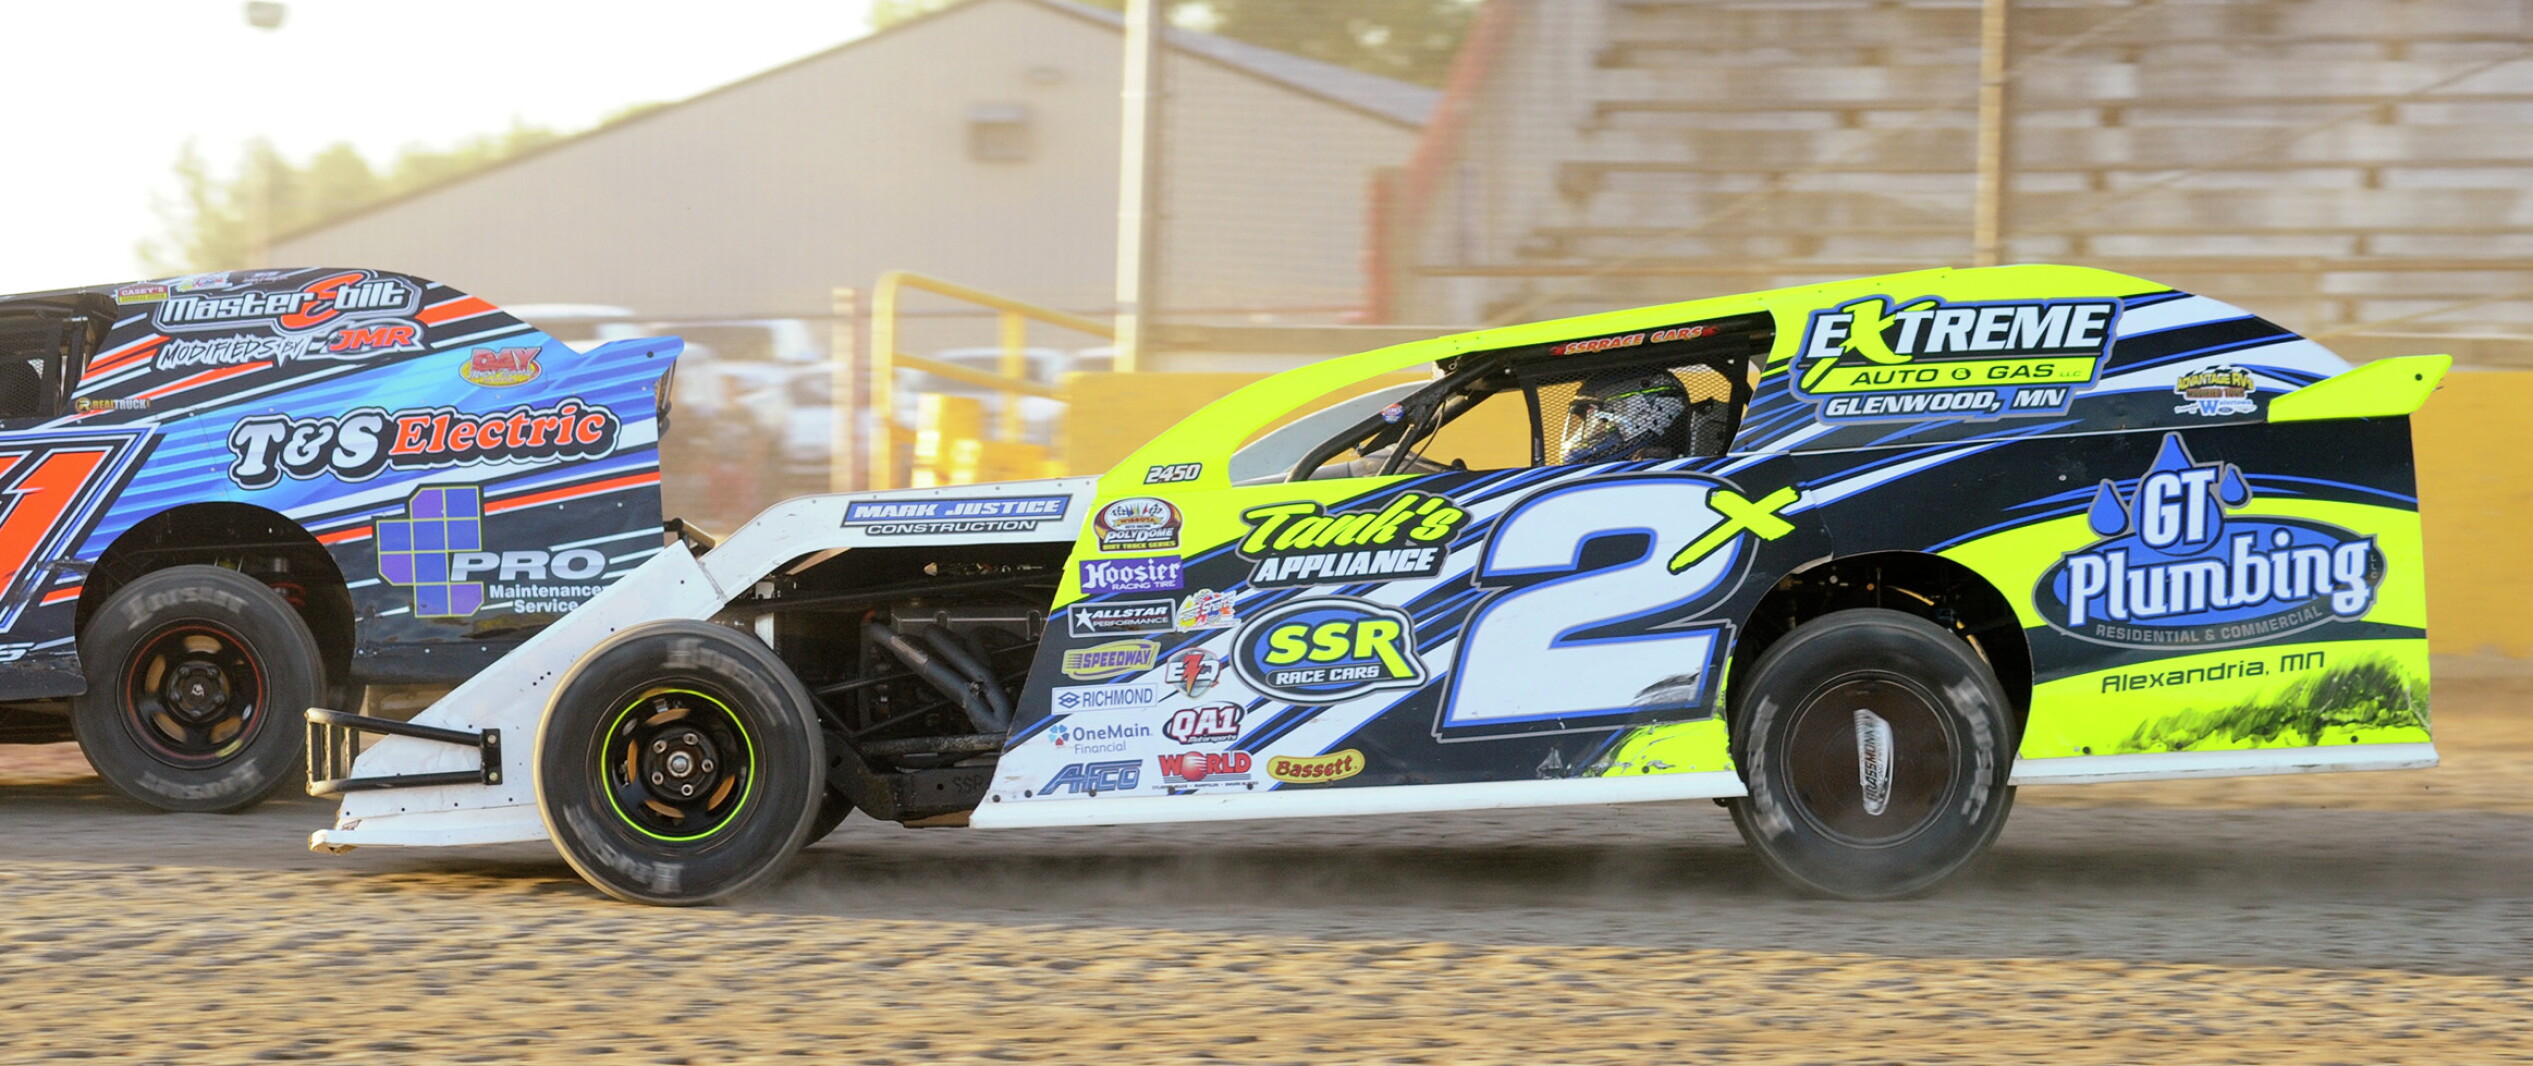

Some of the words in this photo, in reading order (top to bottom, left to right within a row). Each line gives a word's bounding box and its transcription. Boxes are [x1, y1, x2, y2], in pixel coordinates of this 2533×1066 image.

[329, 325, 415, 351] JMR
[1651, 326, 1704, 343] CARS
[1801, 299, 2111, 389] EXTREME
[157, 335, 281, 369] MODIFIEDS
[471, 347, 541, 372] DAY
[1850, 368, 1940, 386] AUTO
[1987, 364, 2055, 380] GAS
[2059, 370, 2082, 378] LLC
[1825, 390, 2001, 417] GLENWOOD,
[2012, 387, 2067, 408] MN
[234, 414, 384, 477] T&S
[389, 404, 606, 456] Electric
[1144, 463, 1202, 484] 2450
[853, 503, 938, 519] MARK
[944, 499, 1062, 516] JUSTICE
[2142, 467, 2218, 548] GT
[867, 519, 1037, 535] CONSTRUCTION
[1242, 494, 1464, 553] Tank's
[450, 548, 606, 582] PRO
[1082, 558, 1181, 589] Hoosier
[1253, 547, 1438, 583] APPLIANCE
[2067, 528, 2373, 627] Plumbing
[489, 584, 602, 599] Maintenance
[1112, 581, 1151, 590] RACING
[1154, 580, 1176, 588] TIRE
[514, 599, 579, 614] Service
[1092, 606, 1169, 619] ALLSTAR
[1093, 616, 1169, 627] PERFORMANCE
[2096, 623, 2200, 643] RESIDENTIAL
[2204, 629, 2215, 640] &
[2221, 605, 2324, 640] COMMERCIAL
[1083, 650, 1151, 669] SPEEDWAY
[1264, 620, 1417, 678] SSR
[1276, 668, 1326, 685] RACE
[1329, 665, 1381, 681] CARS
[2101, 656, 2270, 694] Alexandria,
[1082, 688, 1153, 708] RICHMOND
[1073, 724, 1150, 742] OneMain
[1171, 706, 1238, 742] QA1
[1075, 741, 1127, 755] Financial
[1158, 751, 1252, 782] WORLD
[1275, 754, 1353, 778] Bassett
